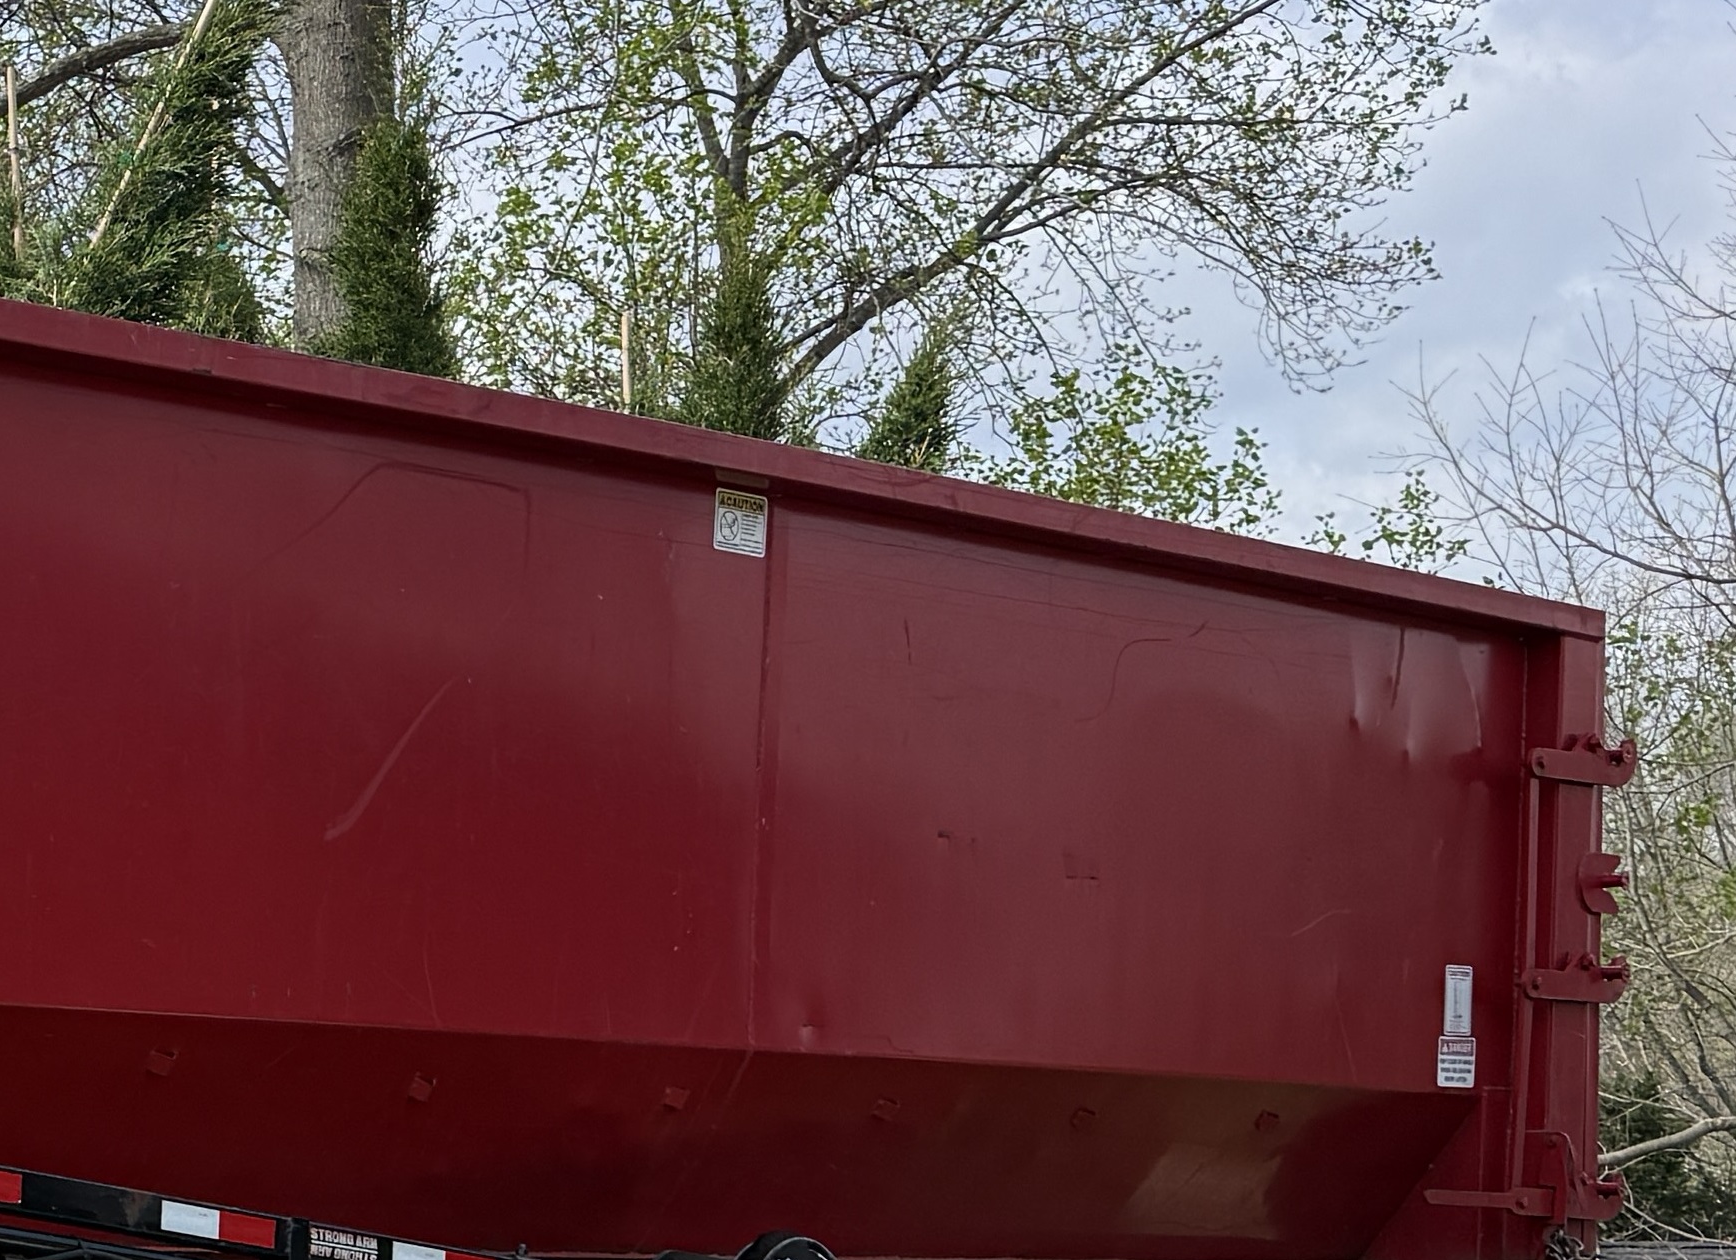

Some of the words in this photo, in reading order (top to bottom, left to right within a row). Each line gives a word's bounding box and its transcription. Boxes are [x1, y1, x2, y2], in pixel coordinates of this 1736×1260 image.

[310, 1227, 354, 1245] STRONG
[355, 1235, 378, 1250] ARM
[310, 1244, 333, 1258] ARM
